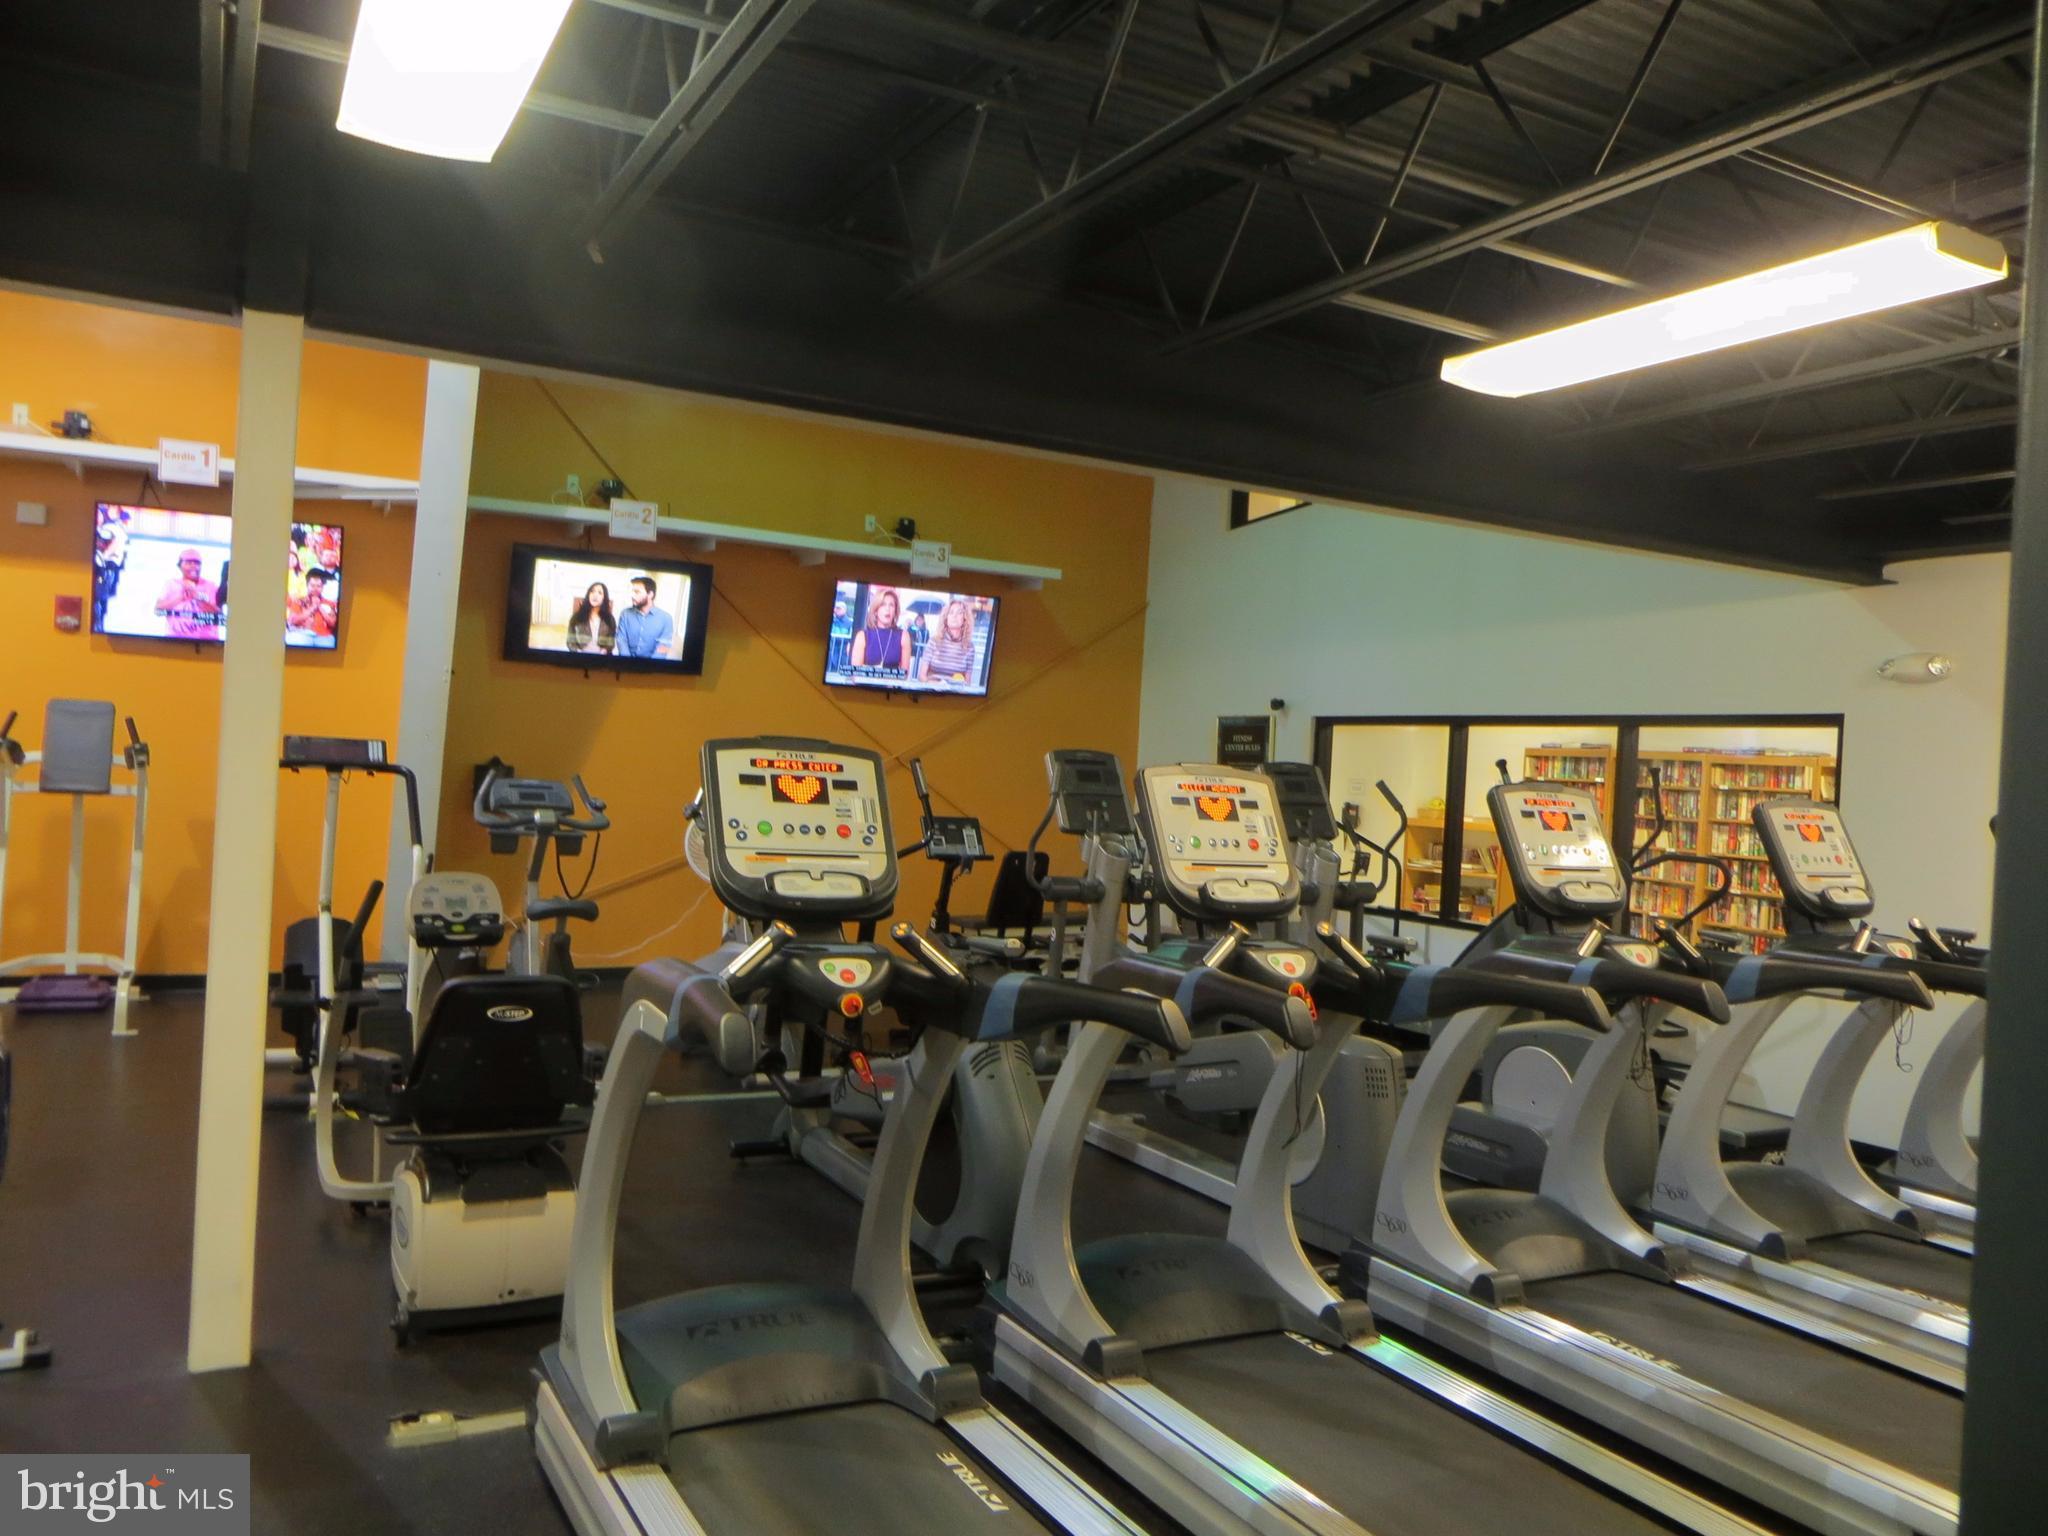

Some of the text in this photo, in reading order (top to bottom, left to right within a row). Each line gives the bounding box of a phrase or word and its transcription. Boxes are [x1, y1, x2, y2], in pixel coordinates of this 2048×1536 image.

[201, 447, 210, 468] 1
[642, 507, 652, 525] 2
[937, 546, 946, 563] 3
[773, 759, 804, 771] PRESS
[808, 762, 838, 773] ENTER
